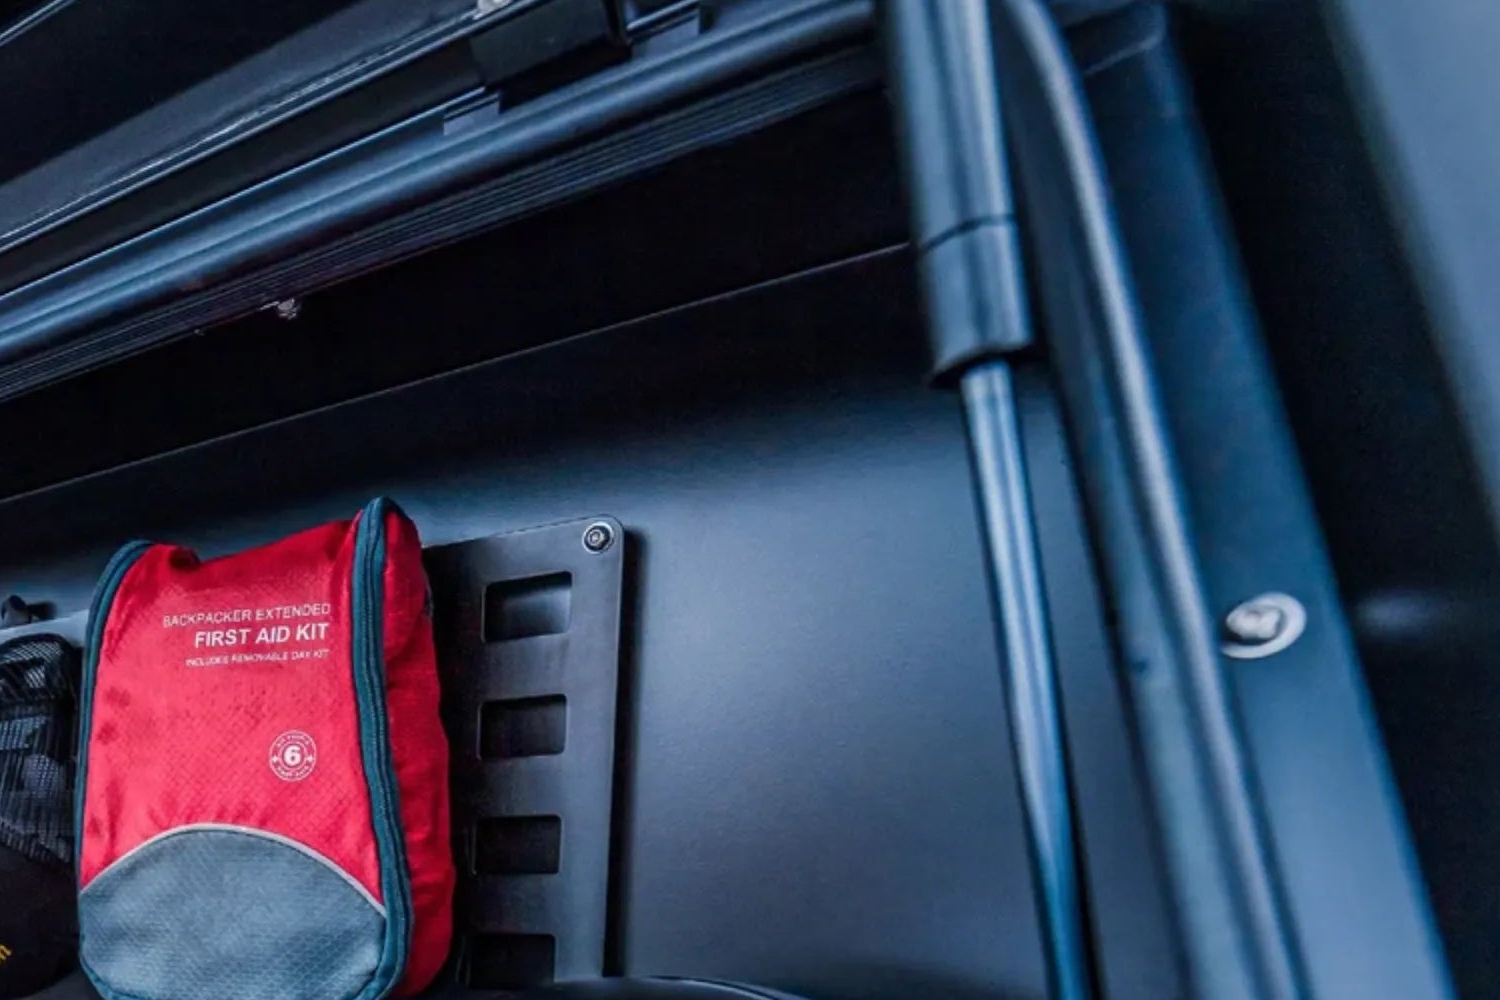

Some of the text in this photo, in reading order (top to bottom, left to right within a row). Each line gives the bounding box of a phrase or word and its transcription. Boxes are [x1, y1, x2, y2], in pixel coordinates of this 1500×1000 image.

[163, 603, 331, 628] BACKPACKER EXTENDED
[194, 622, 330, 648] FIRST AID KIT
[231, 651, 289, 664] REMOVABLE
[284, 745, 301, 765] 6
